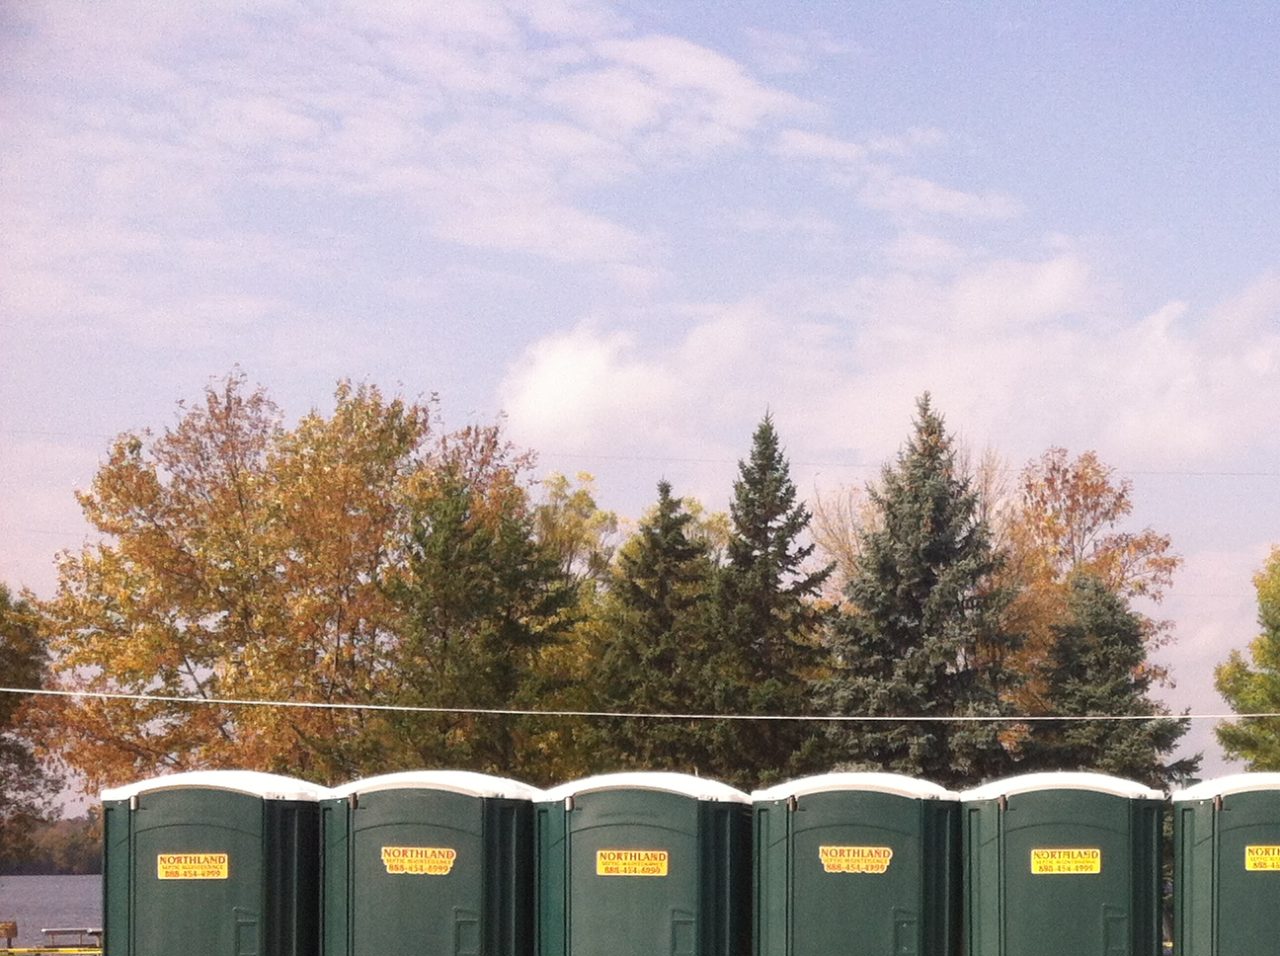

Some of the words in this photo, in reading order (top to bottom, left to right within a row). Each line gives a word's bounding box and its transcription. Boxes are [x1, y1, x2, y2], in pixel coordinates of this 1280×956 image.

[384, 849, 454, 859] NORTHLAND
[600, 852, 666, 861] NORTHLAND
[821, 848, 891, 858] NORTHLAND
[1034, 850, 1098, 859] NORTHLAND
[160, 856, 225, 864] NORTHLAND
